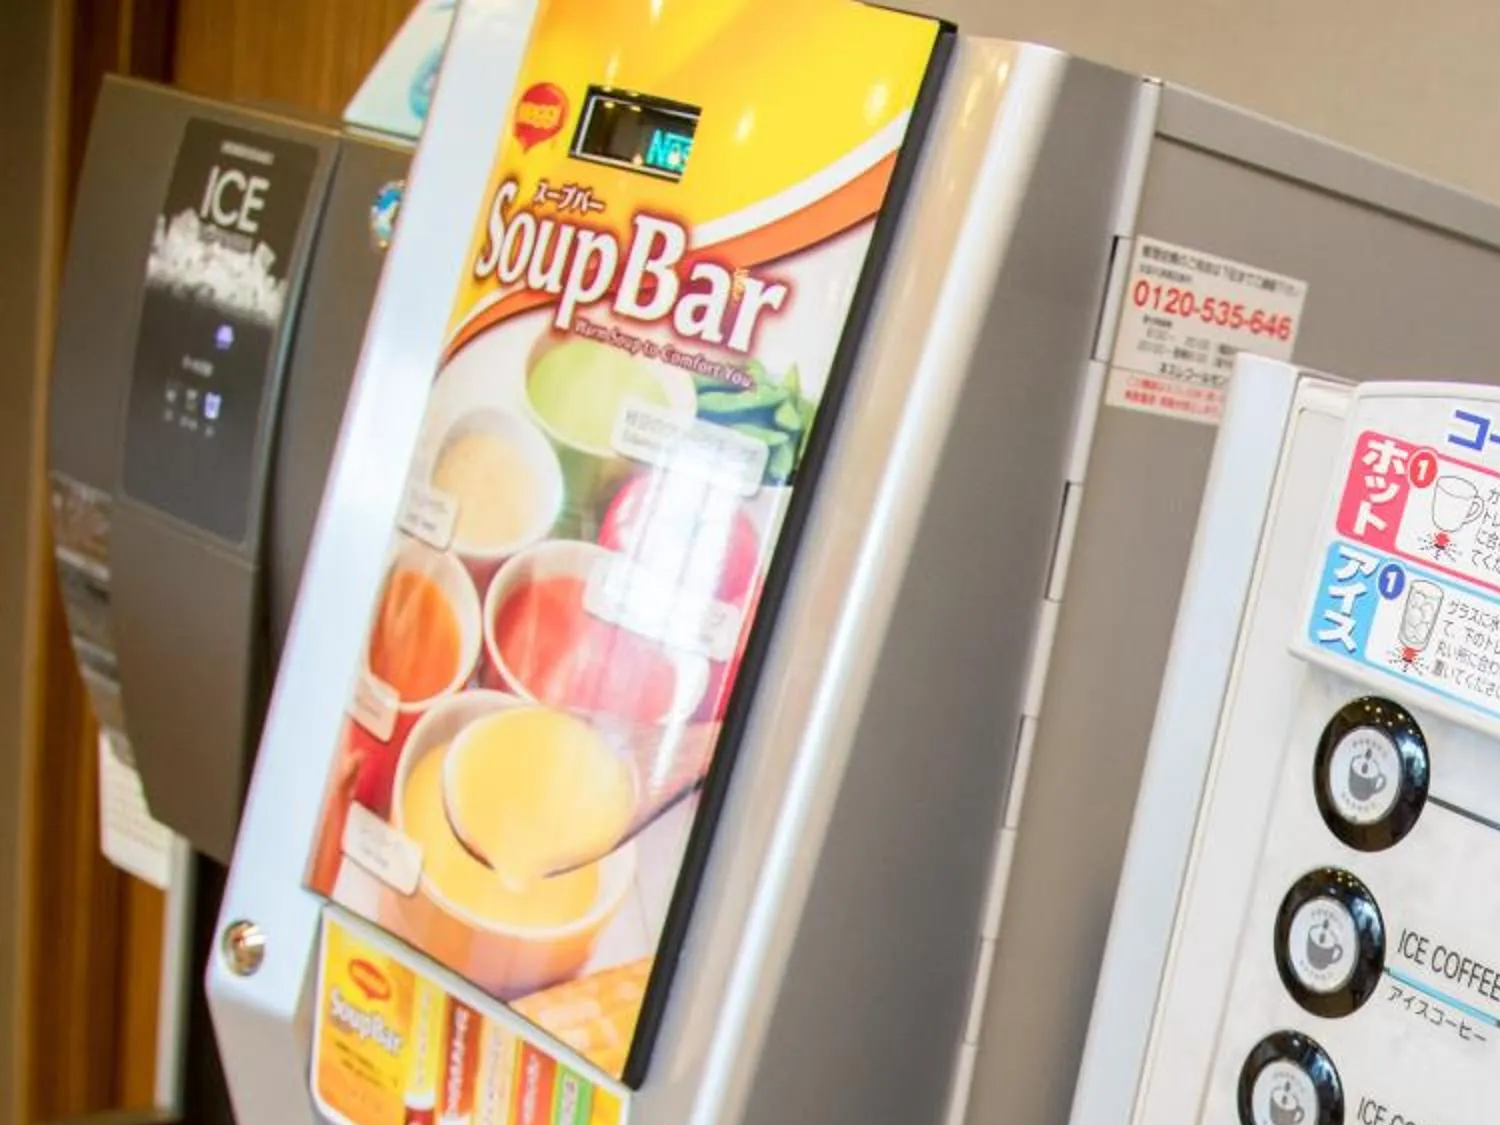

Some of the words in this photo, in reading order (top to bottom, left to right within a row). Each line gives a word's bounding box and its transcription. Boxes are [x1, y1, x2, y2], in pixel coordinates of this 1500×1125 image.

[201, 166, 269, 233] ICE
[534, 180, 605, 214] スープバー
[475, 180, 618, 330] Soup
[613, 214, 786, 352] Bar
[1133, 280, 1293, 341] 0120-535-646
[661, 344, 720, 378] Comfort
[1354, 439, 1409, 536] ホット
[1317, 546, 1381, 653] アイス
[1398, 927, 1430, 966] ICE
[1387, 985, 1488, 1043] アイスコーヒー
